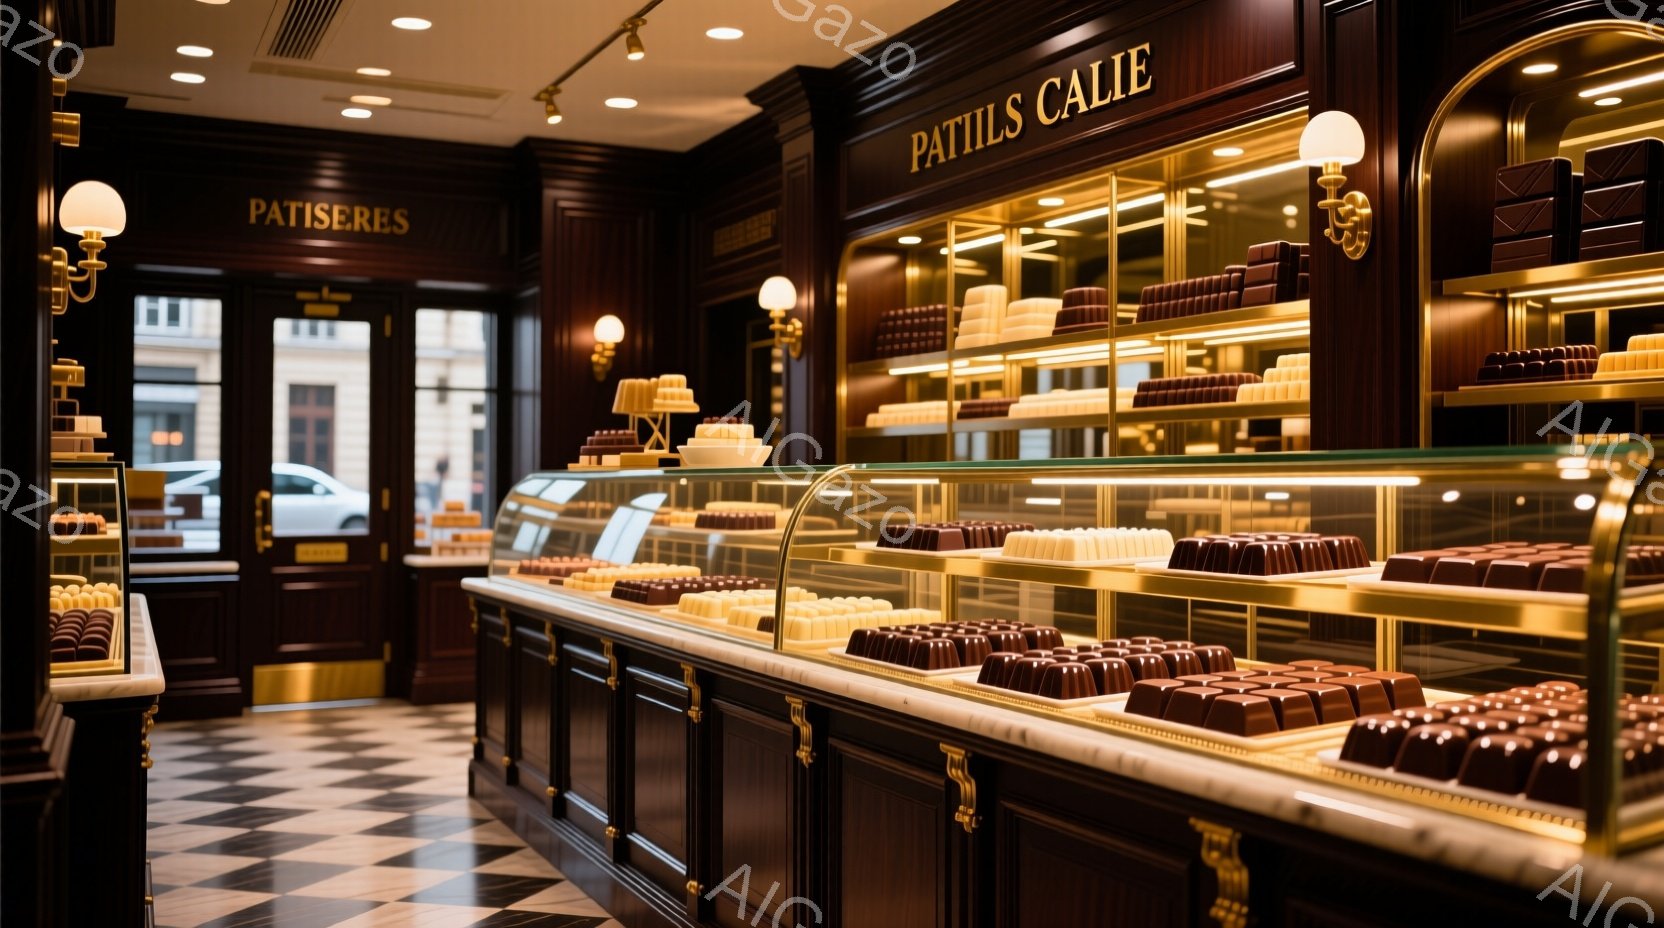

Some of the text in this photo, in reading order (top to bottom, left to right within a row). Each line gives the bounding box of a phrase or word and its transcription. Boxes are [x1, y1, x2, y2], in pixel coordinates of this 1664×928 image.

[910, 42, 1152, 174] PATIILS CALIE
[248, 198, 411, 236] PATISERES
